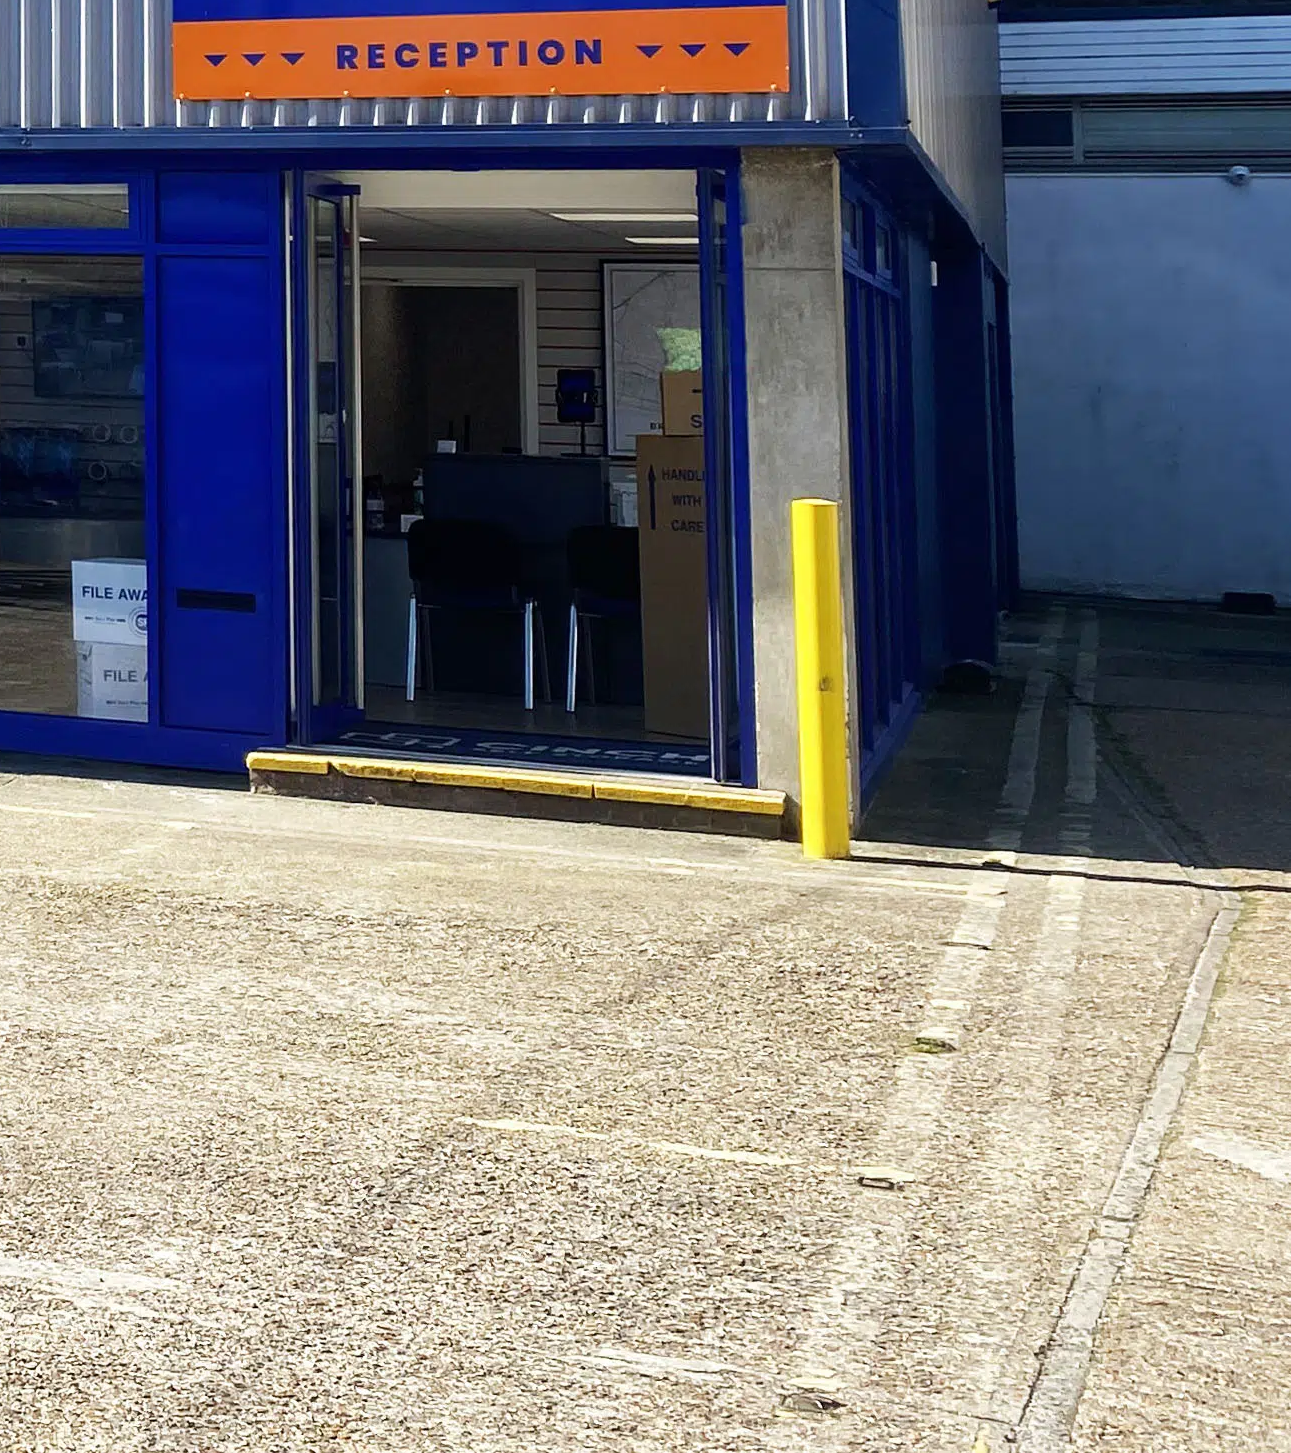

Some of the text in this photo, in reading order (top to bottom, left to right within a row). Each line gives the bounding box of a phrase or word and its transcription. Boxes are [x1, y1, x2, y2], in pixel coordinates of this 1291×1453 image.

[336, 38, 602, 70] RECEPTION
[672, 494, 702, 507] WITH
[670, 519, 705, 533] CARE
[81, 585, 148, 601] FILE AWA
[103, 669, 138, 683] FILE
